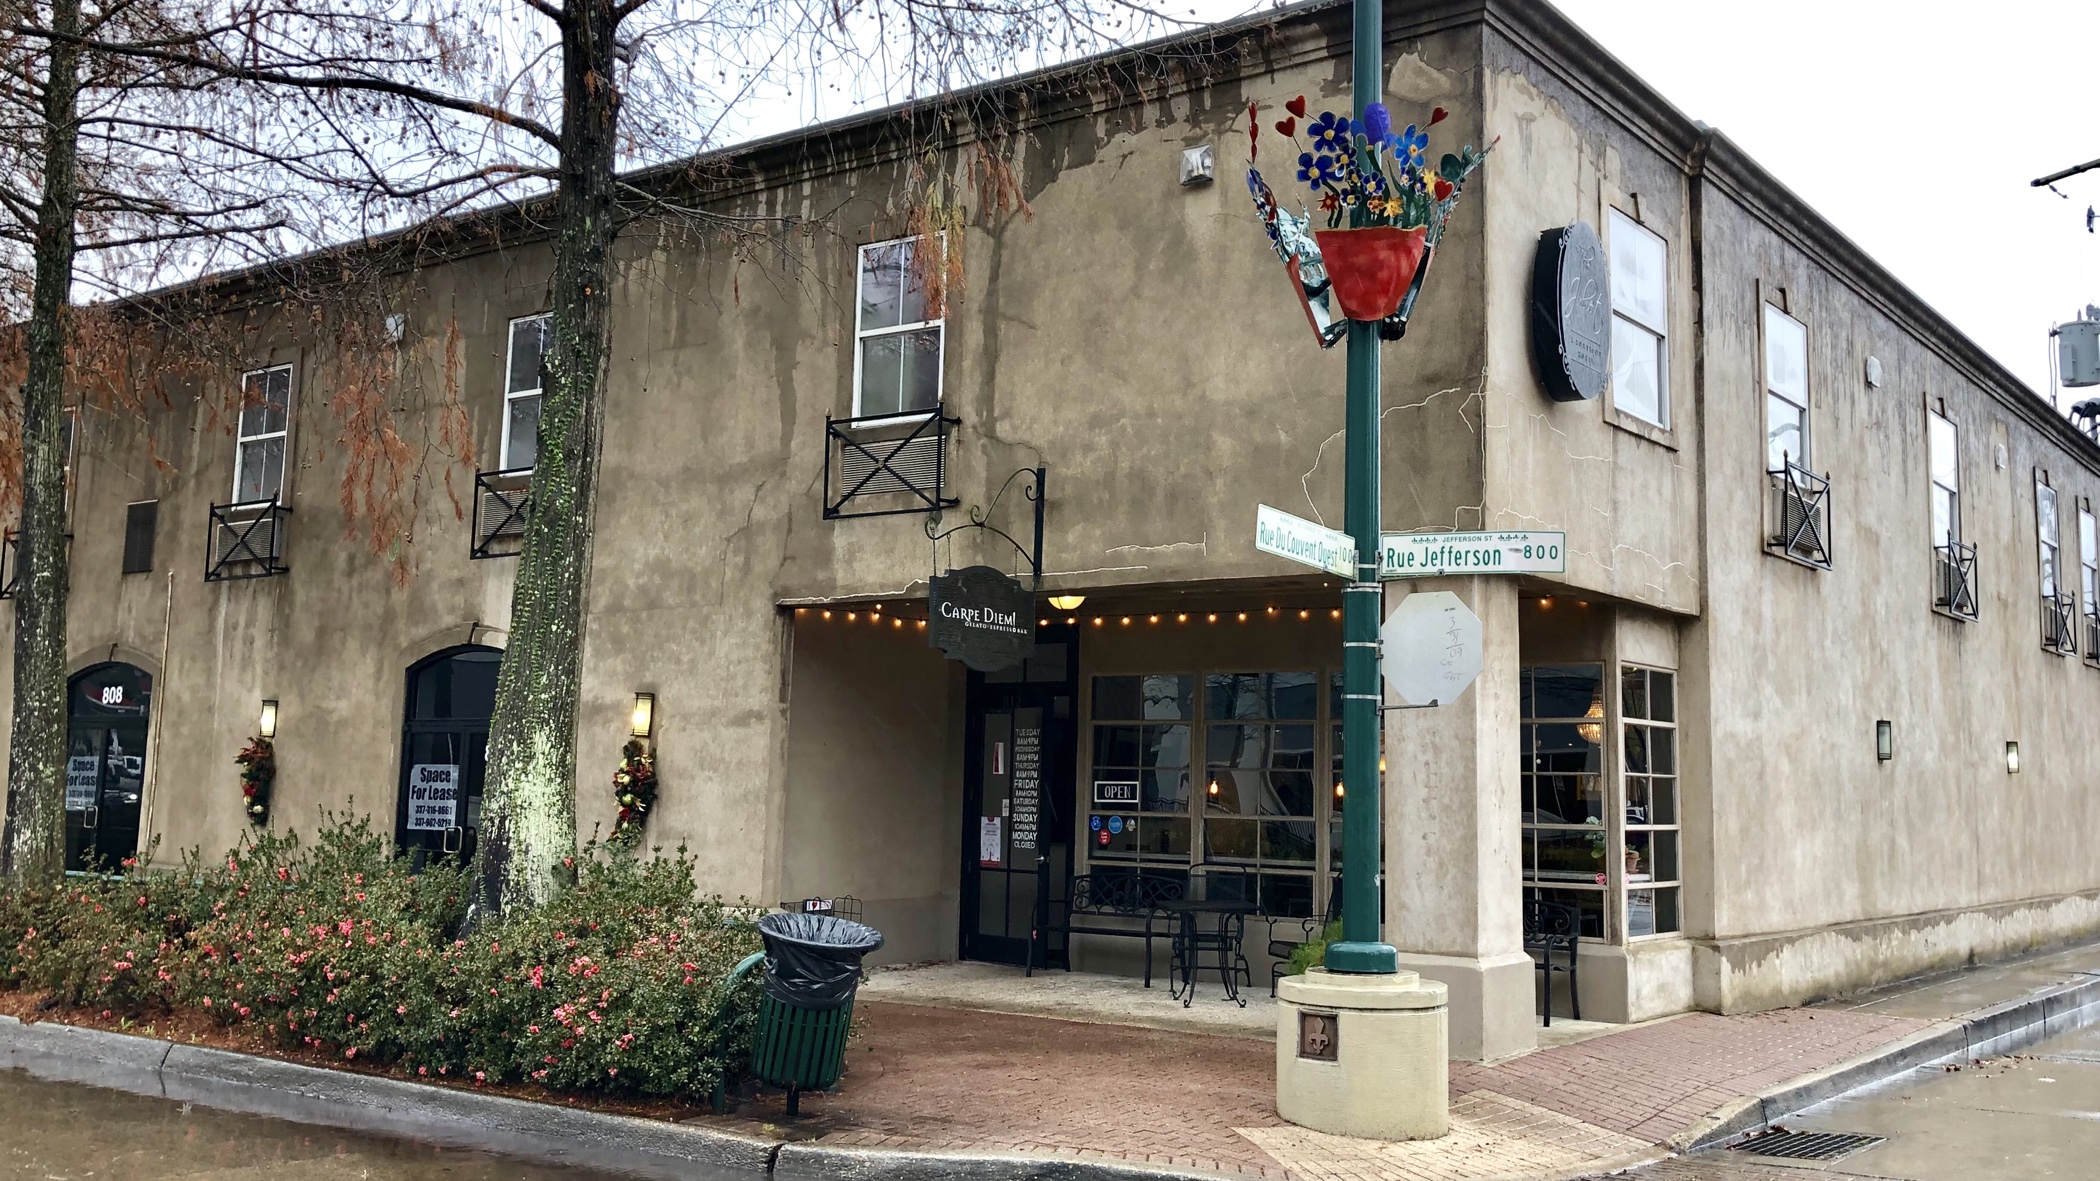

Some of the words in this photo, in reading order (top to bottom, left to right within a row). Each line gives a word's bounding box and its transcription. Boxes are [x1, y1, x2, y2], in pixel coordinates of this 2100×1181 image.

[1259, 521, 1275, 547] Rue
[1276, 526, 1286, 551] Du
[1287, 530, 1317, 561] Couvent
[1318, 541, 1338, 567] Ouest
[1339, 546, 1353, 564] 100
[1386, 547, 1415, 568] Rue
[1420, 545, 1502, 567] Jefferson
[1523, 544, 1558, 560] 800
[941, 601, 980, 623] CARPE
[102, 686, 123, 704] 808
[1015, 728, 1041, 736] TUESDAY
[72, 758, 95, 773] Space
[78, 773, 96, 786] Leas
[420, 767, 451, 784] Space
[1013, 779, 1040, 789] FRIDAY
[411, 785, 427, 800] For
[428, 785, 458, 800] Lease
[1104, 785, 1131, 799] OPEN
[1013, 797, 1039, 805] SATURDAY
[1012, 813, 1038, 823] SUNDAY
[1012, 831, 1038, 841] MONDAY
[1013, 841, 1036, 849] CLOSED
